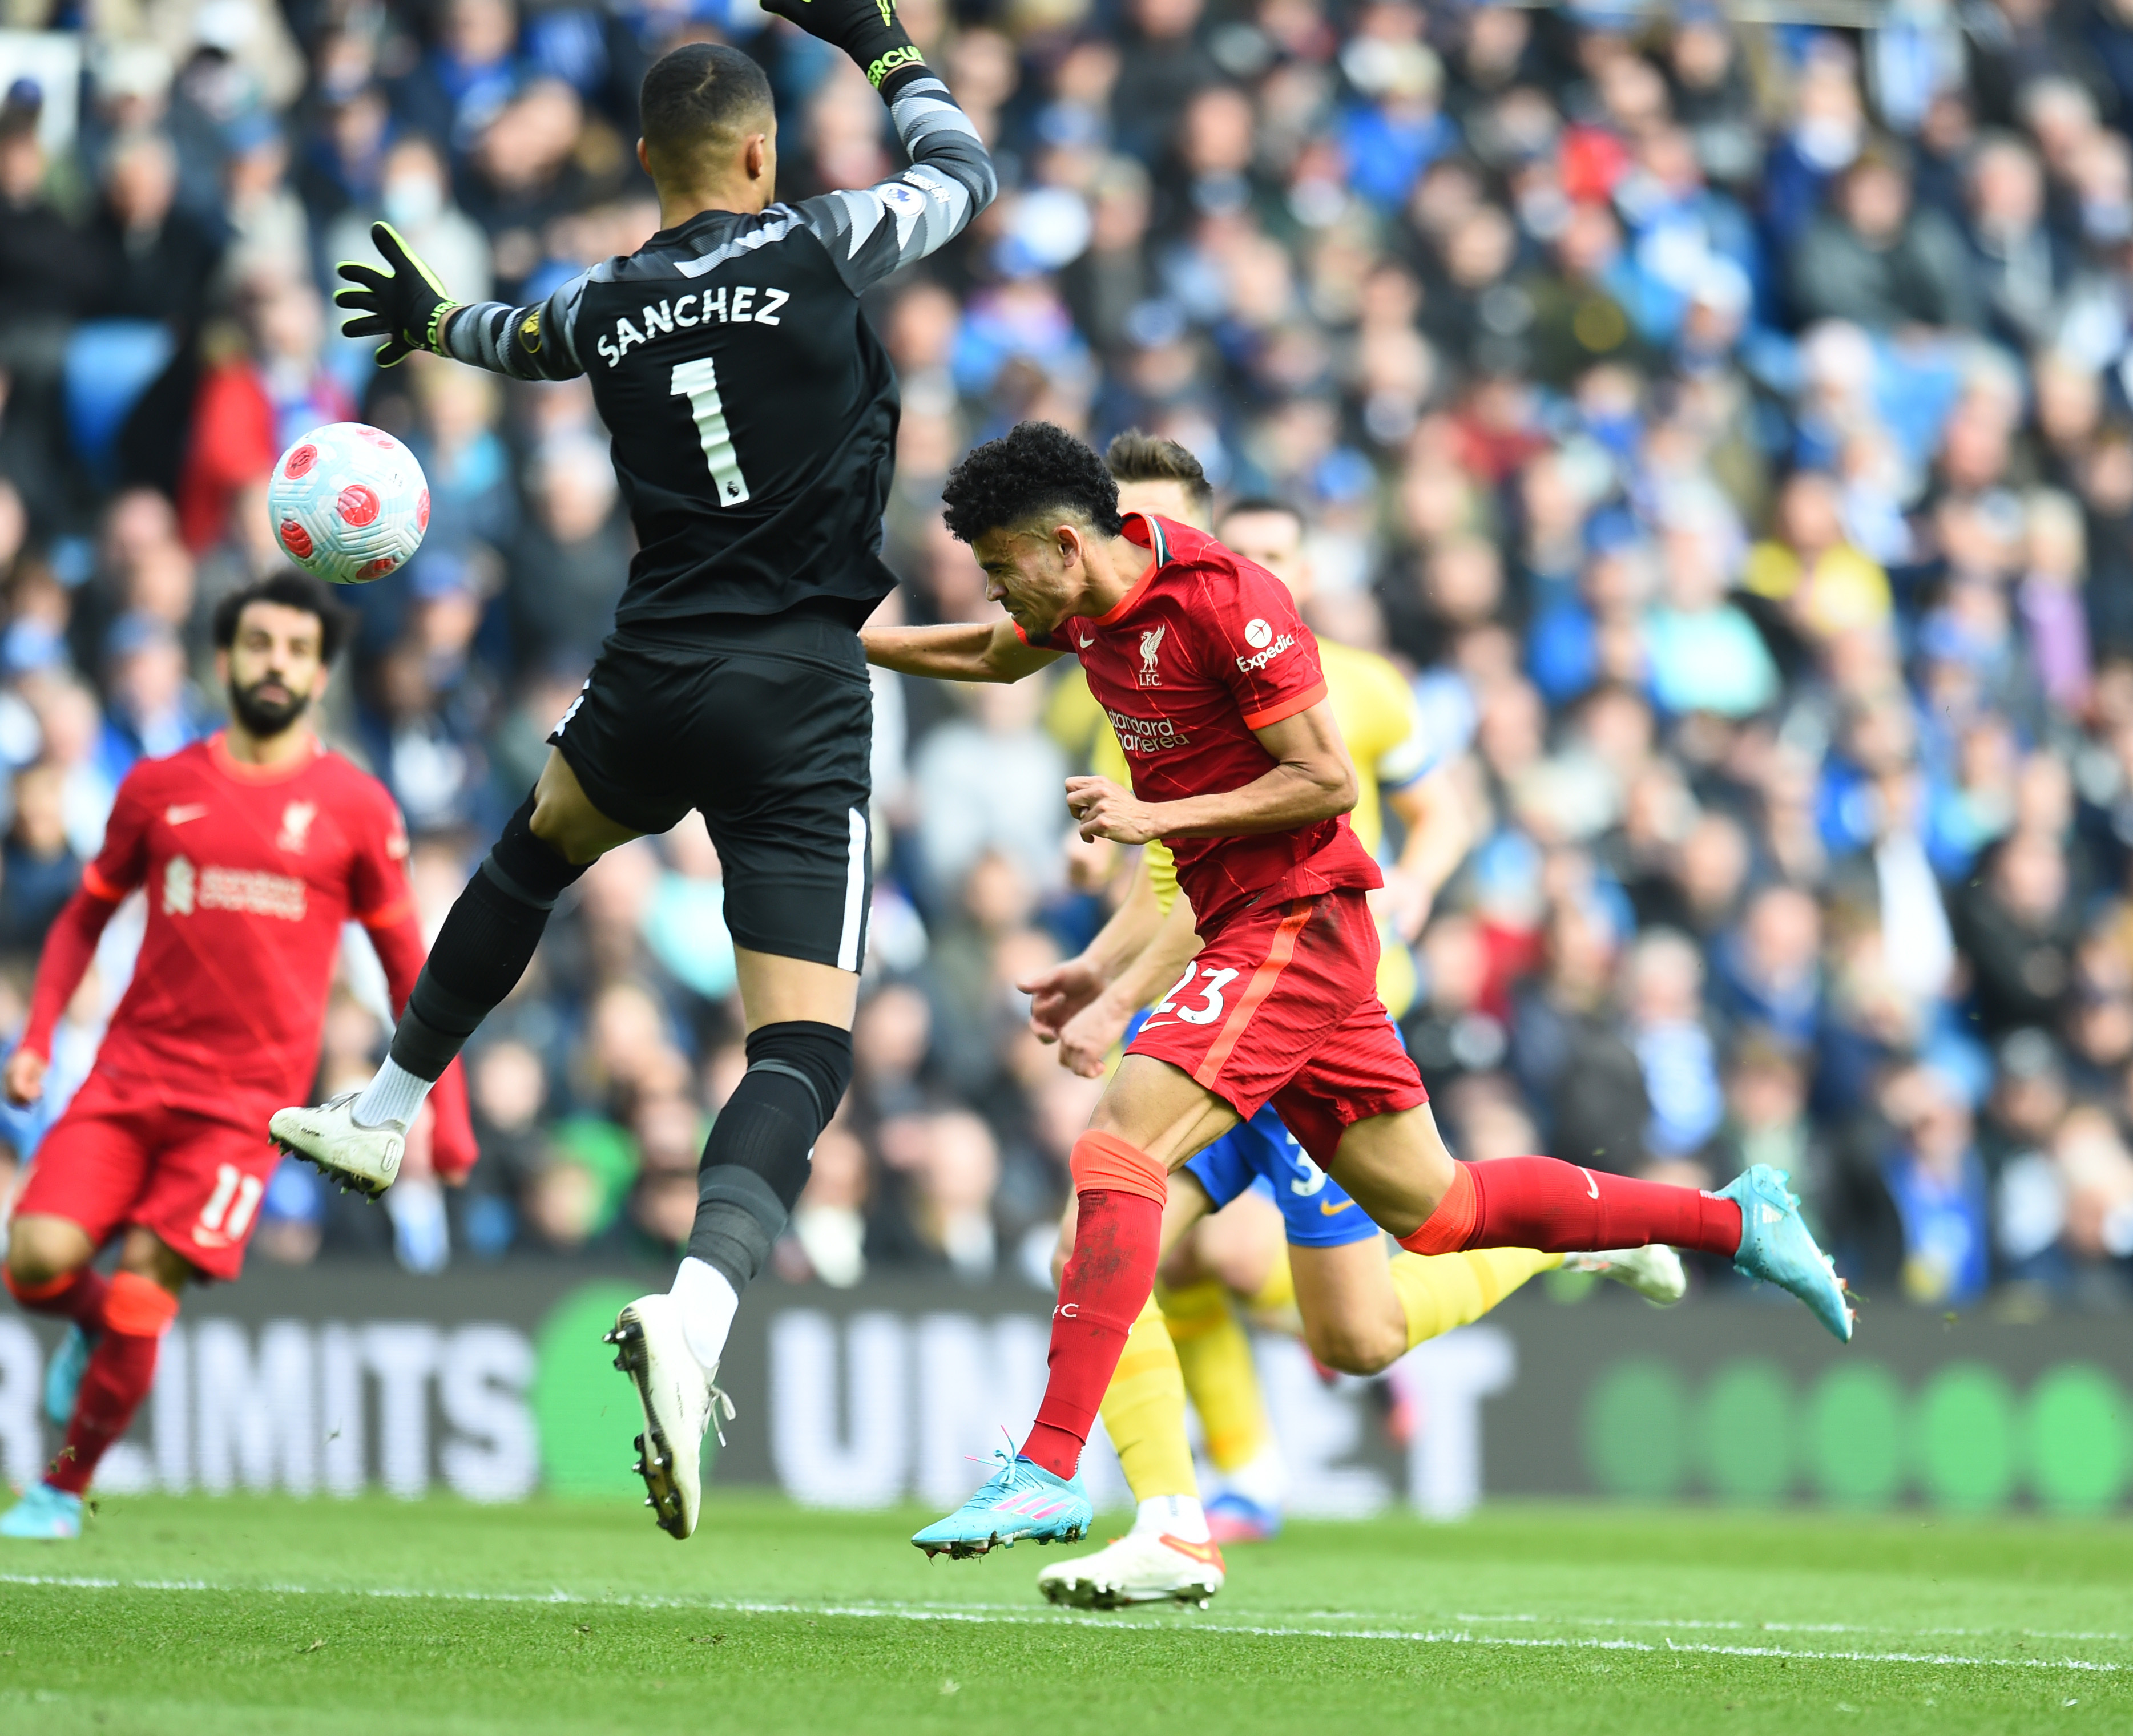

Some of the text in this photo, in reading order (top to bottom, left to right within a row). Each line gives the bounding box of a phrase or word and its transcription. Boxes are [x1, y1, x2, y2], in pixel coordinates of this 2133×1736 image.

[597, 286, 790, 368] SANCHEZ
[670, 357, 750, 507] 1
[1139, 674, 1162, 687] L.F.C.
[1236, 633, 1295, 673] Expedia
[1150, 960, 1239, 1024] 23
[201, 1163, 264, 1240] 11
